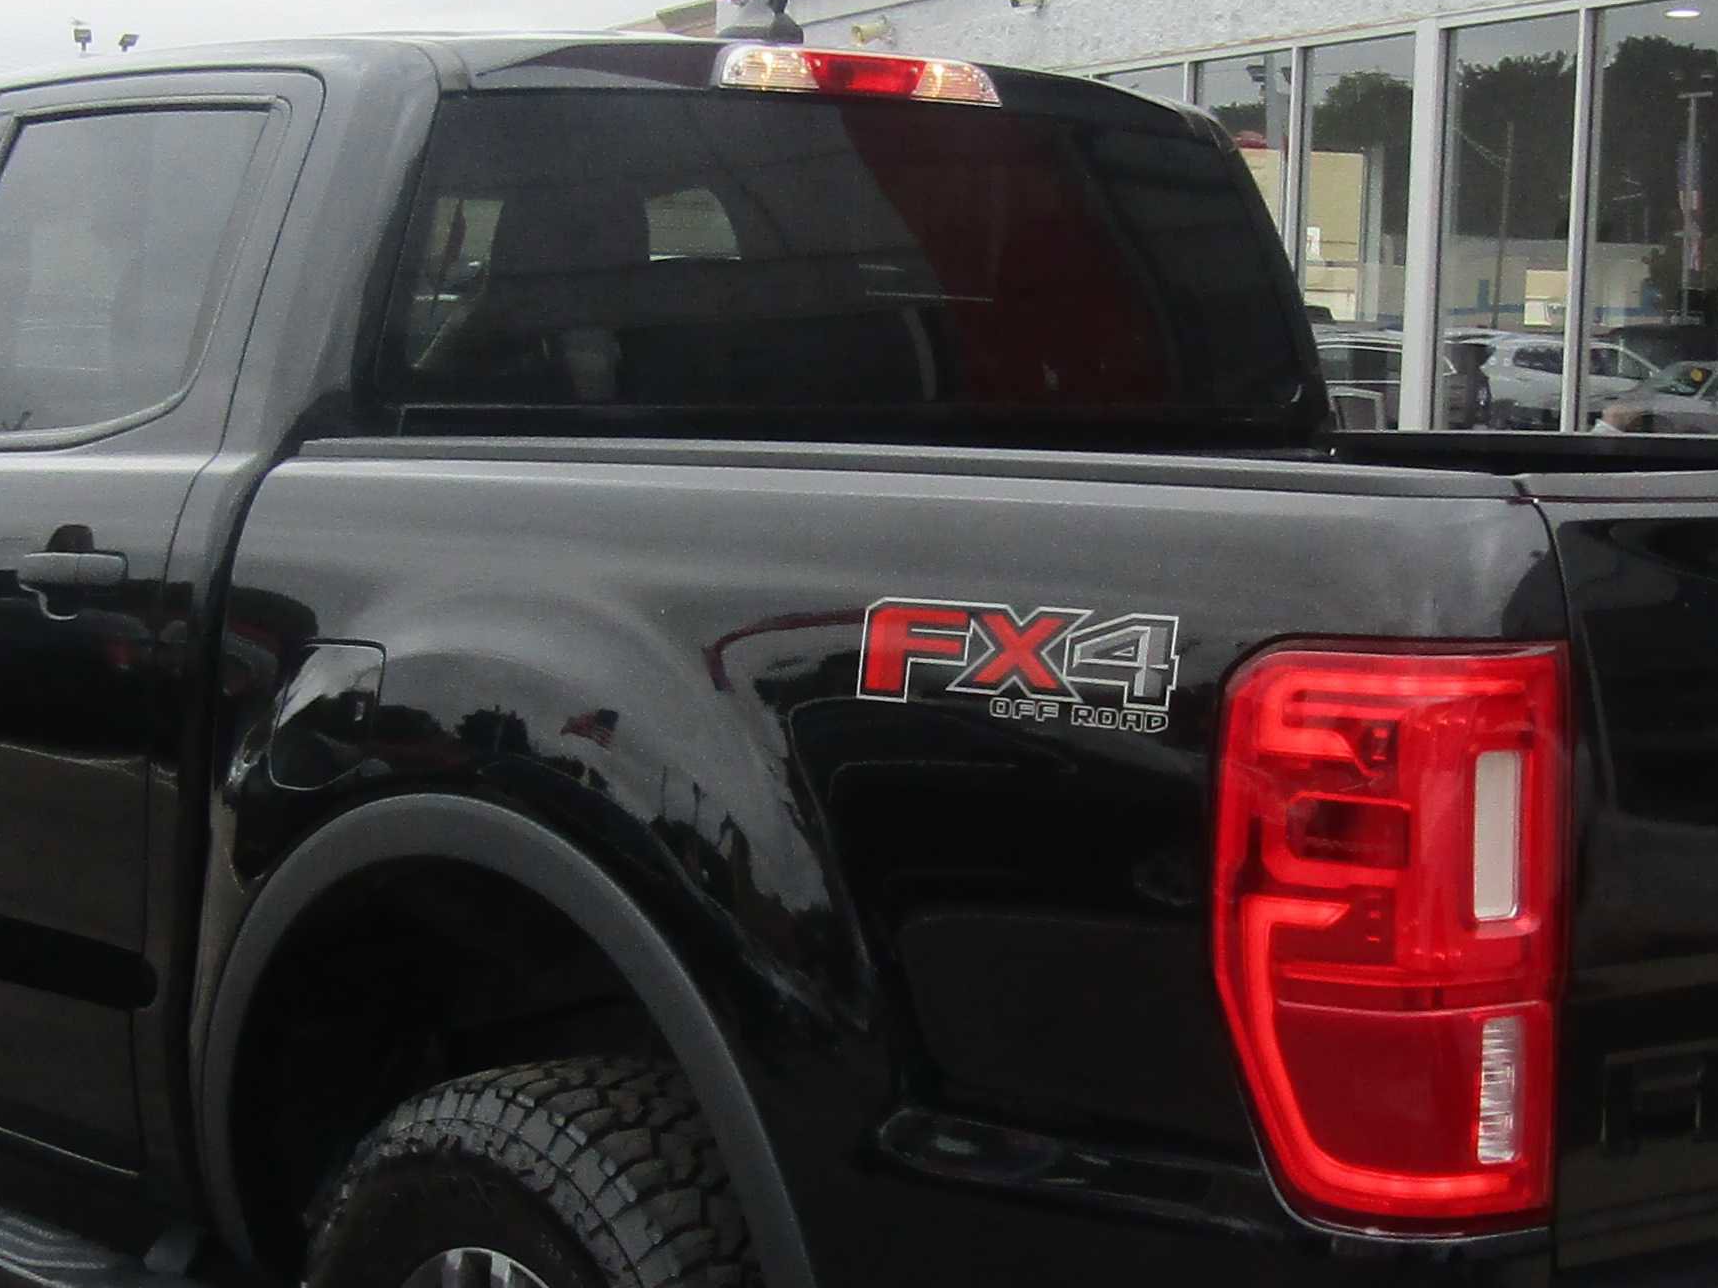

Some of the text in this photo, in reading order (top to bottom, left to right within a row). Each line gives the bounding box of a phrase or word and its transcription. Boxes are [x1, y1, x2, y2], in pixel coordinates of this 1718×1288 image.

[855, 596, 1179, 711] FX4
[989, 697, 1169, 733] OFF ROAD
